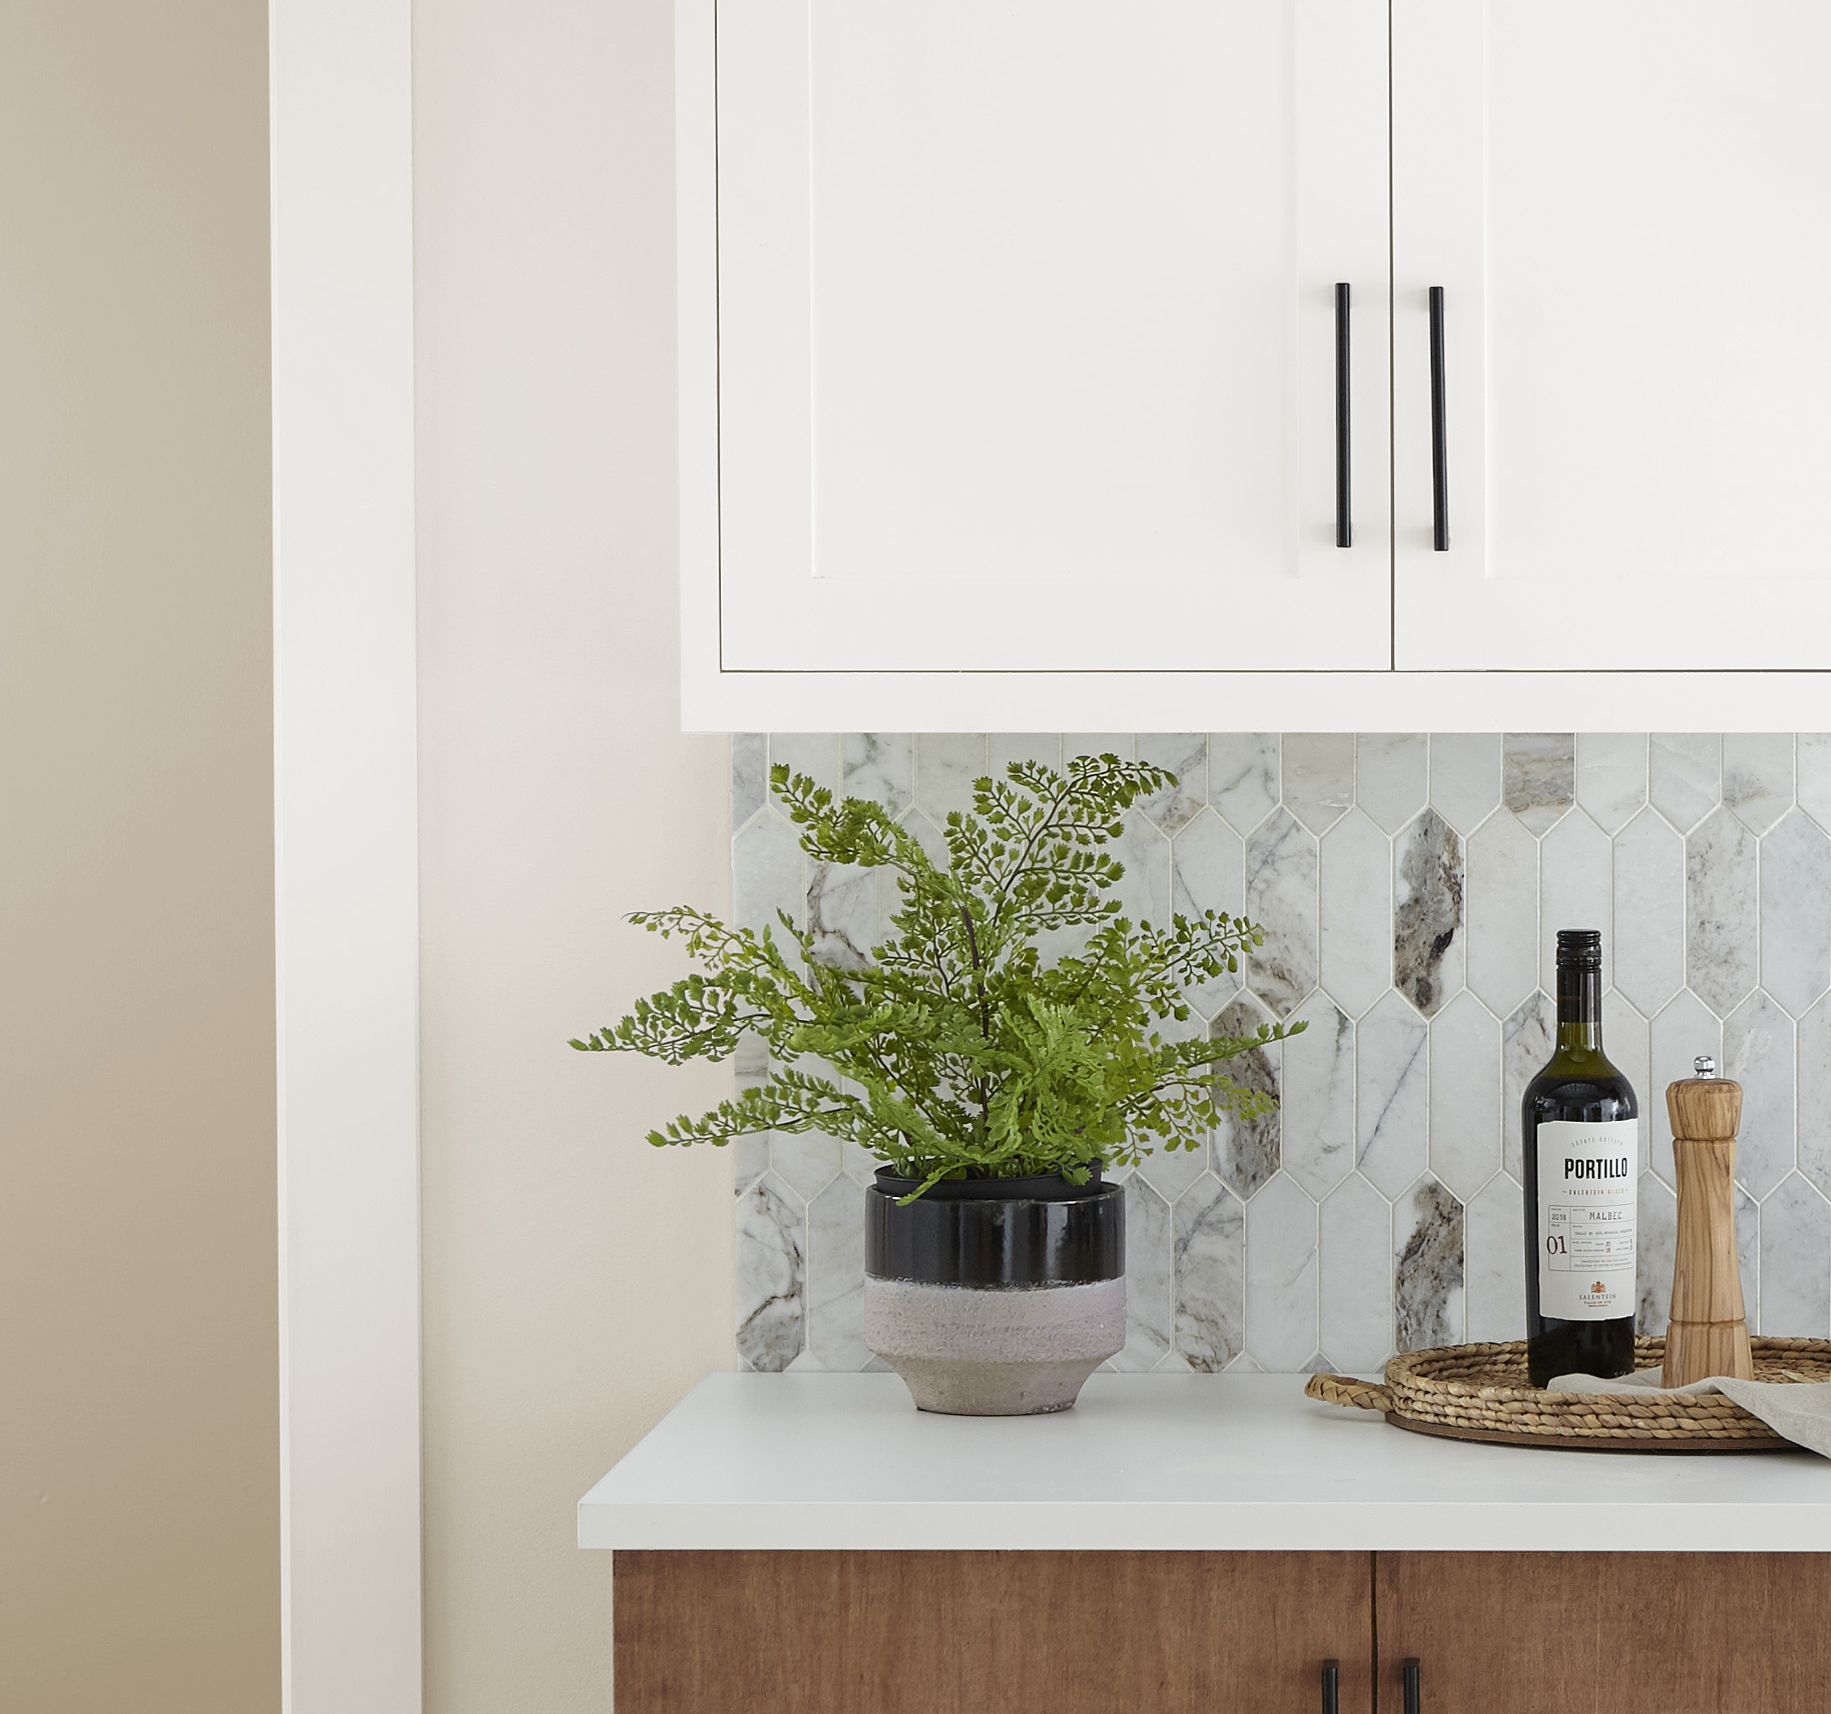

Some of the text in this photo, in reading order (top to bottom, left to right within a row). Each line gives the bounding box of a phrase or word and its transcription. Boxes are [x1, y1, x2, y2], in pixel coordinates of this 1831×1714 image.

[1564, 1157, 1628, 1180] PORTILLO
[1589, 1211, 1622, 1221] MALBEC
[1546, 1235, 1568, 1255] 01
[1578, 1293, 1617, 1301] SALENTEIN
